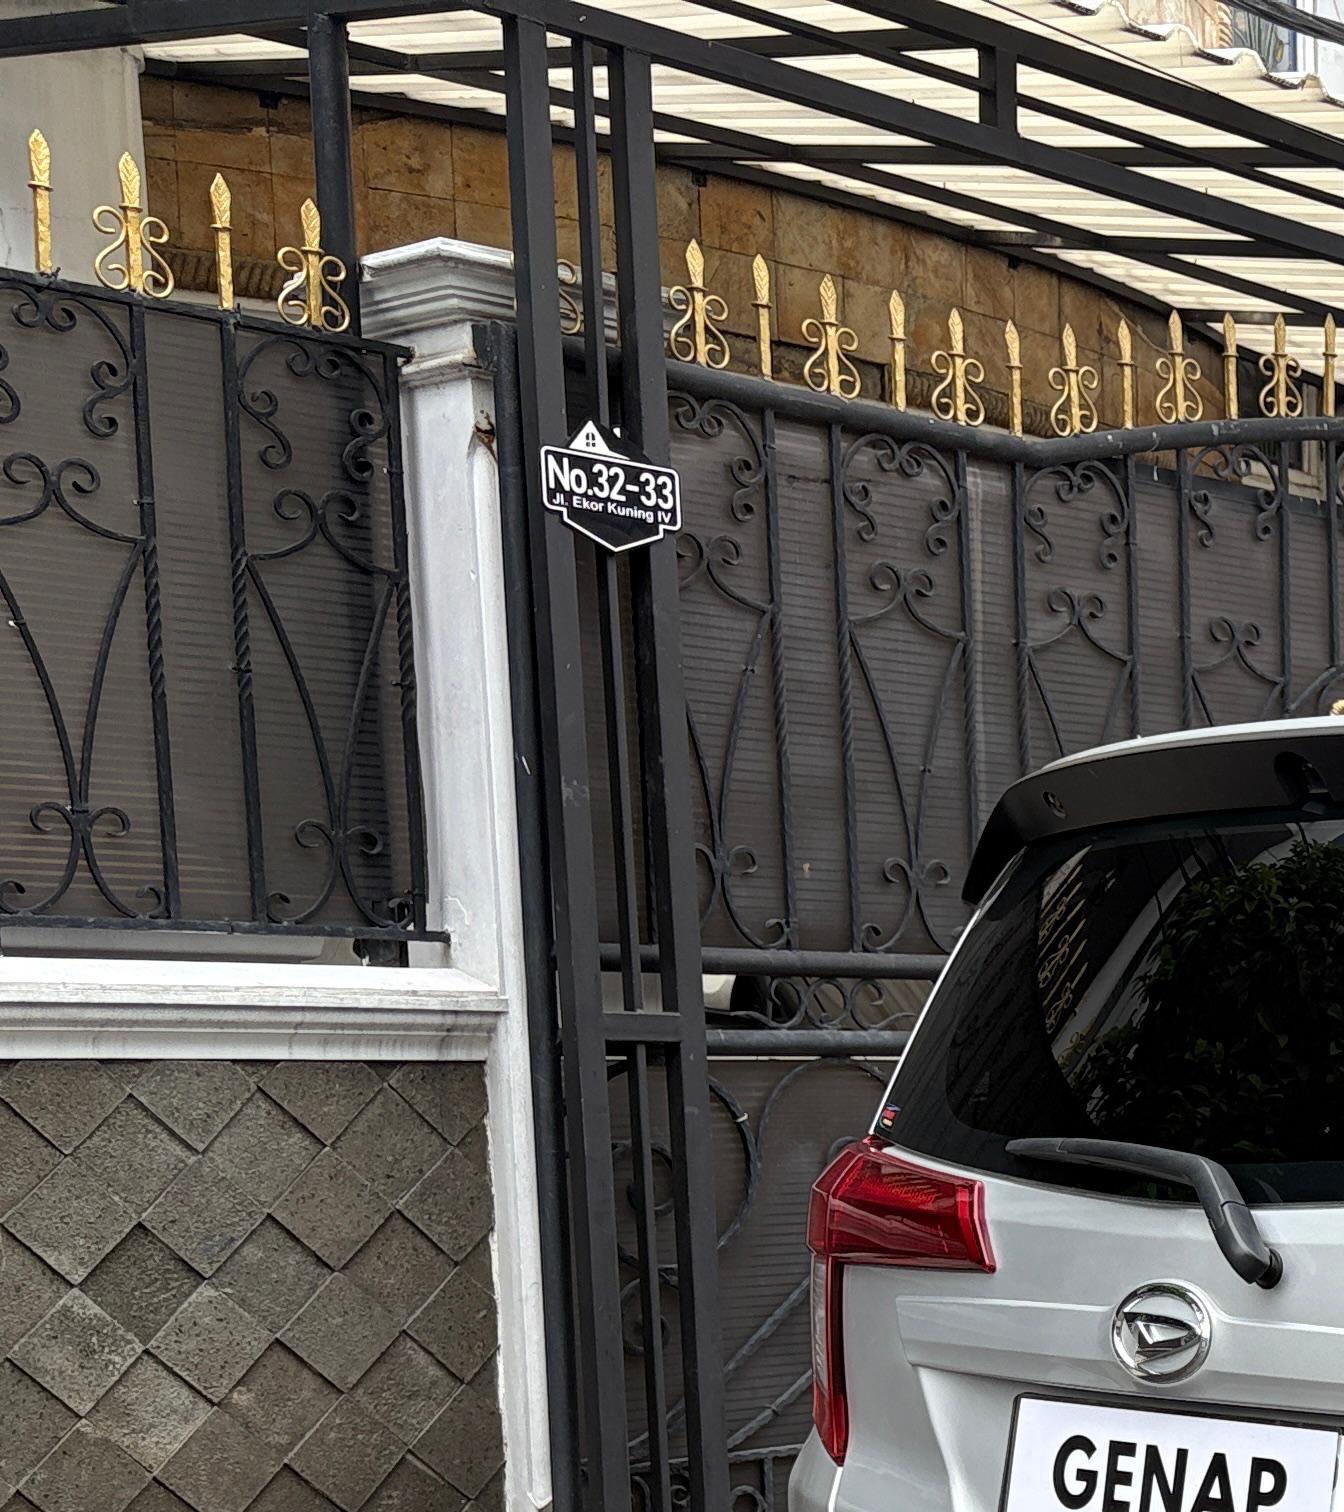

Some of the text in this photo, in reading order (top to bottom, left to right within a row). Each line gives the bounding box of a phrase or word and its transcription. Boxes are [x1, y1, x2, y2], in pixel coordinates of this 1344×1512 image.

[547, 454, 674, 509] No.32-33
[572, 495, 605, 512] Ekor
[607, 502, 654, 523] Kuning
[657, 511, 672, 524] IV
